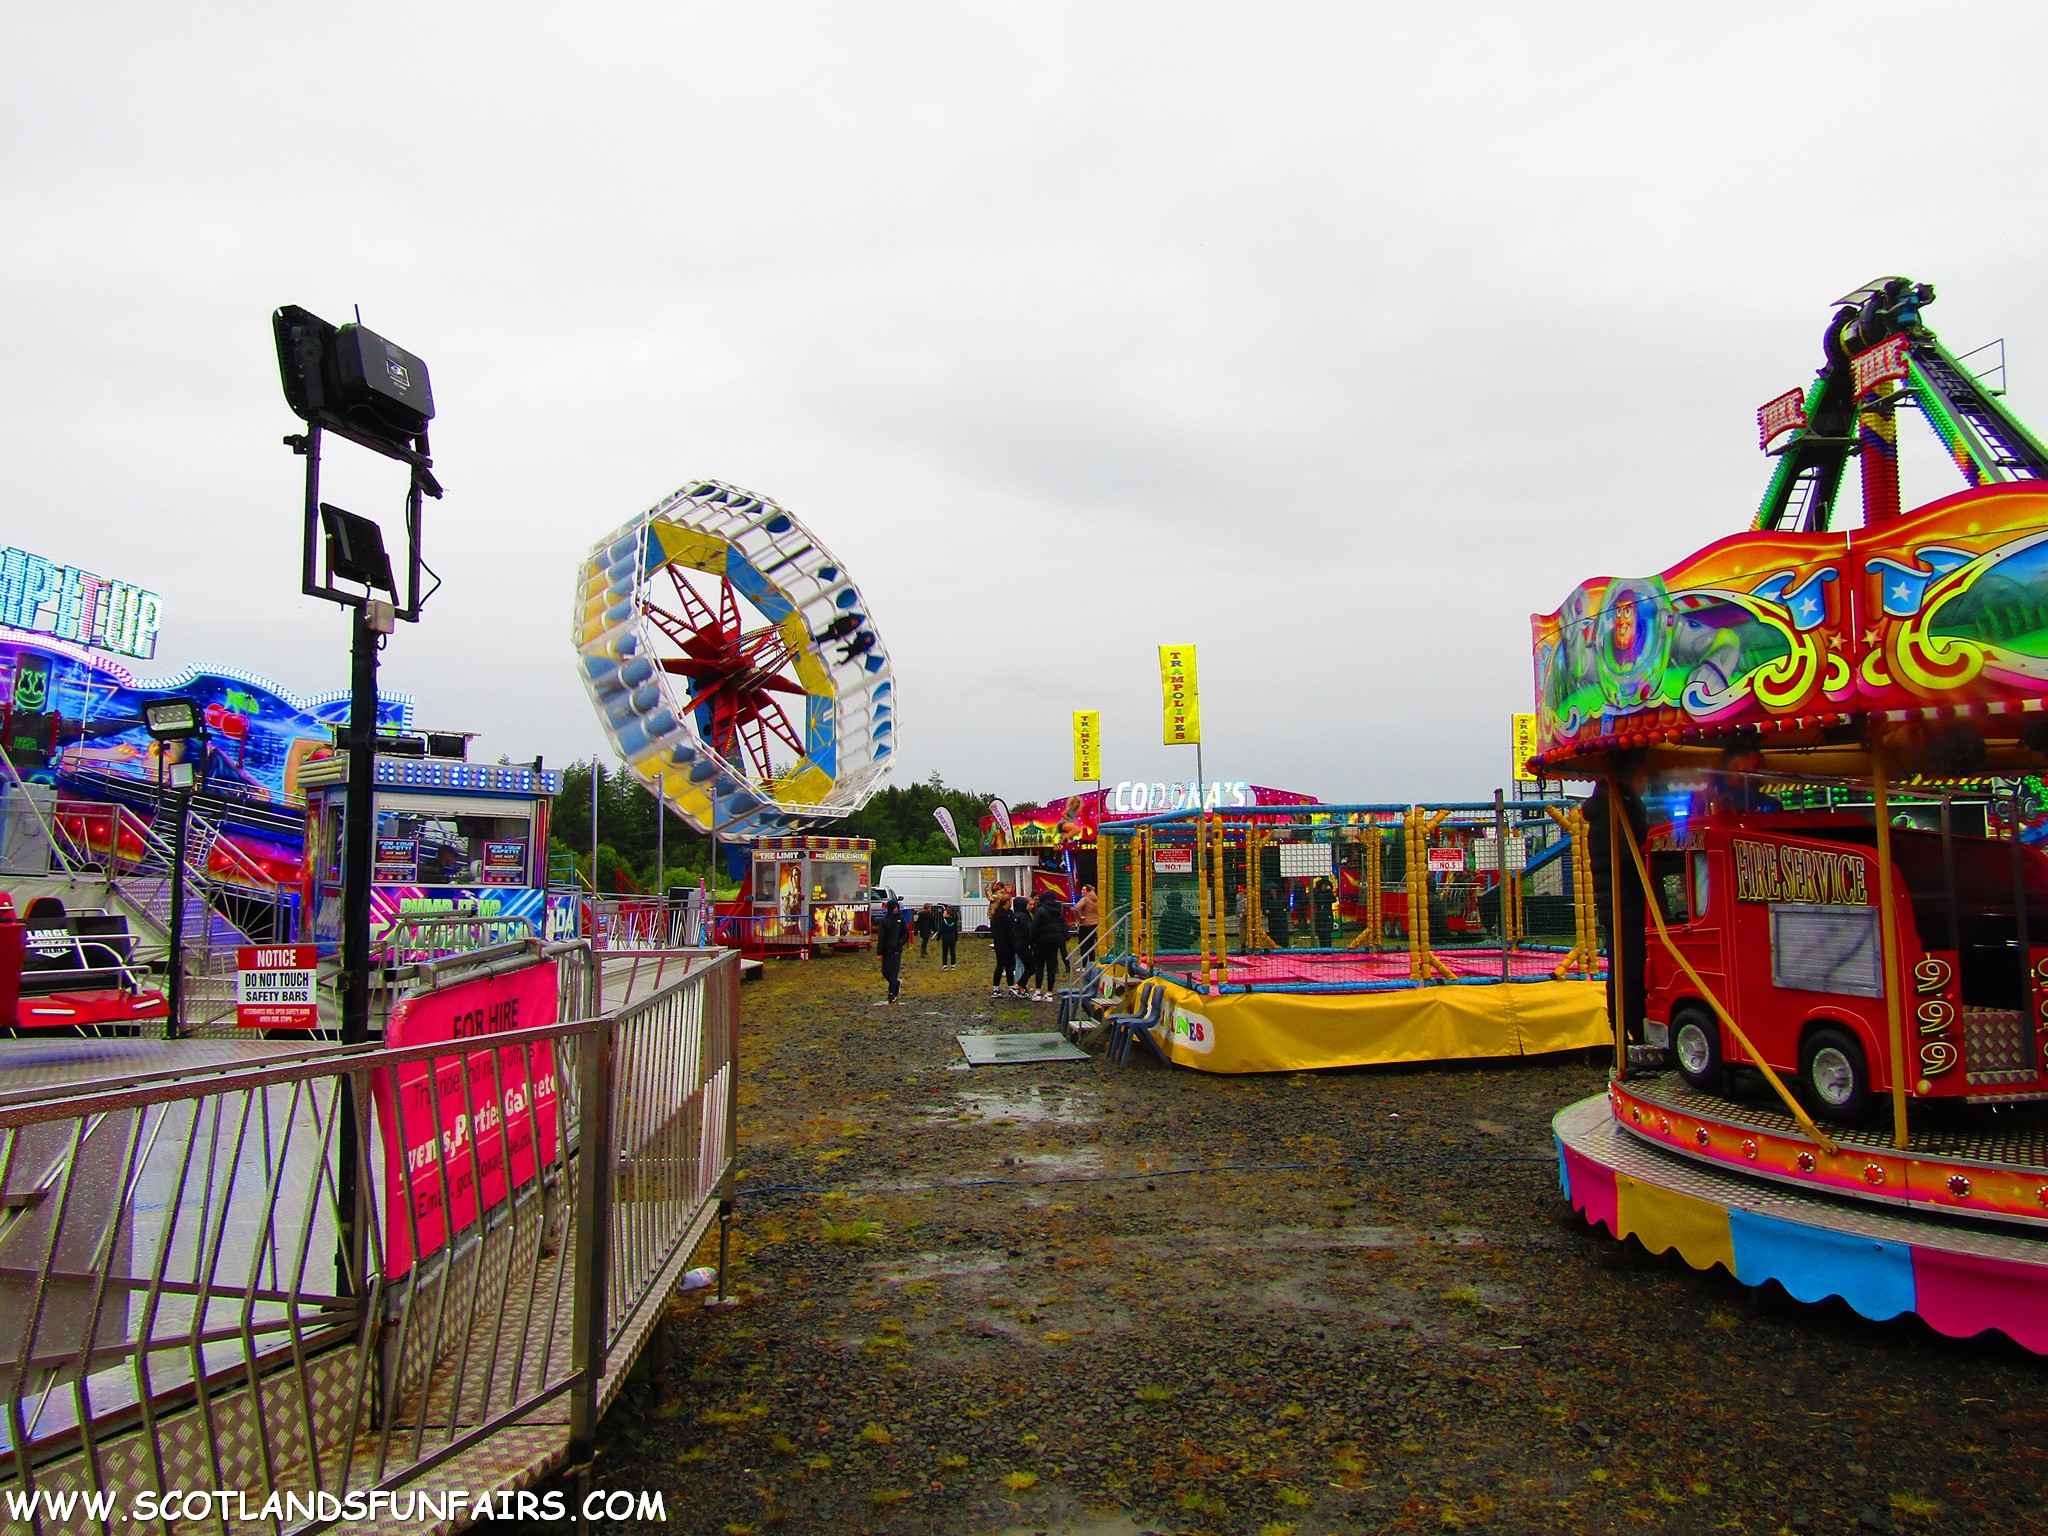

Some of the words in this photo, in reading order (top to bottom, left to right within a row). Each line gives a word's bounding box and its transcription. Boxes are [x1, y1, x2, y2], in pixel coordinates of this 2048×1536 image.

[55, 565, 103, 645] IT
[103, 579, 163, 659] UP
[1169, 652, 1186, 740] TRAMPOLINES
[1080, 715, 1090, 778] TRAMPOLINES
[1114, 780, 1246, 812] CODONA'S
[1651, 830, 1706, 852] BORDER
[759, 852, 775, 860] THE
[776, 852, 799, 860] LIMIT
[847, 852, 864, 860] LIMIT
[1733, 838, 1781, 901] FIRE
[1779, 844, 1868, 906] SERVICE
[834, 904, 850, 912] THE
[851, 904, 869, 912] LIMIT
[26, 928, 70, 938] LARGE
[257, 949, 297, 968] NOTICE
[245, 972, 257, 988] DO
[259, 972, 278, 987] NOT
[279, 972, 309, 987] TOUCH
[245, 991, 280, 1002] SAFETY
[282, 990, 308, 1002] BARS
[453, 1009, 484, 1039] FOR
[488, 998, 519, 1035] HIRE
